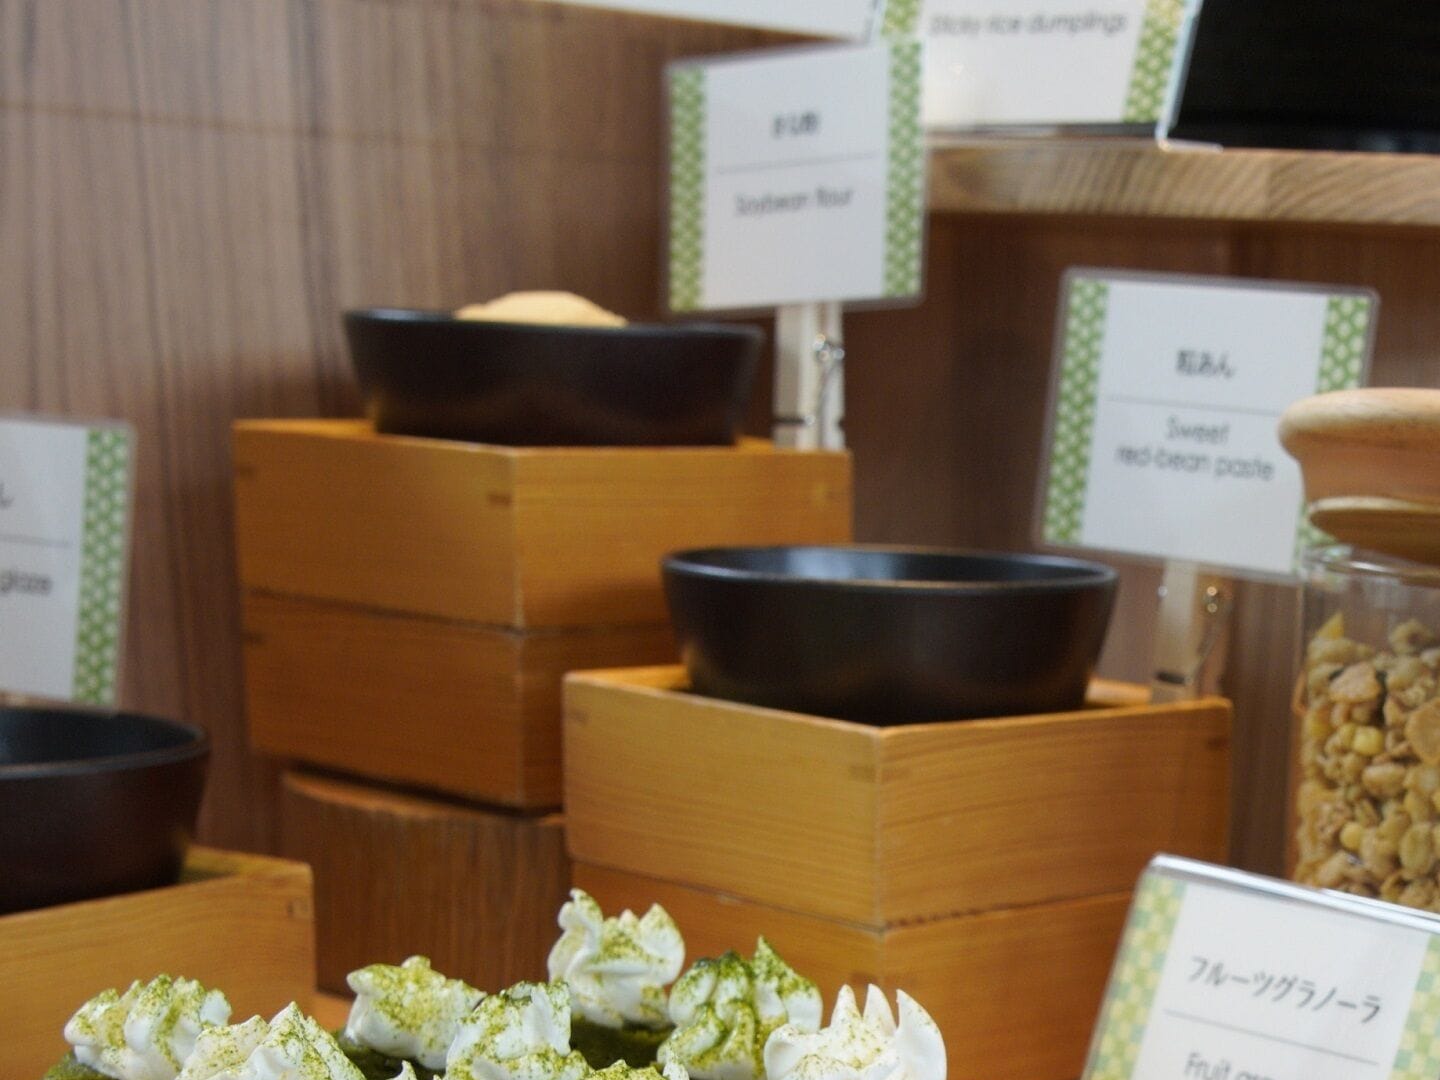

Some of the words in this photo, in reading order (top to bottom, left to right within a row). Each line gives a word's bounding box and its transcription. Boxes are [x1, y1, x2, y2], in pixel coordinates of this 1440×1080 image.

[1028, 11, 1128, 37] dumplings
[1167, 414, 1230, 443] Sweet
[1214, 456, 1274, 482] paste
[1187, 955, 1382, 1024] フルーツグラノーラ
